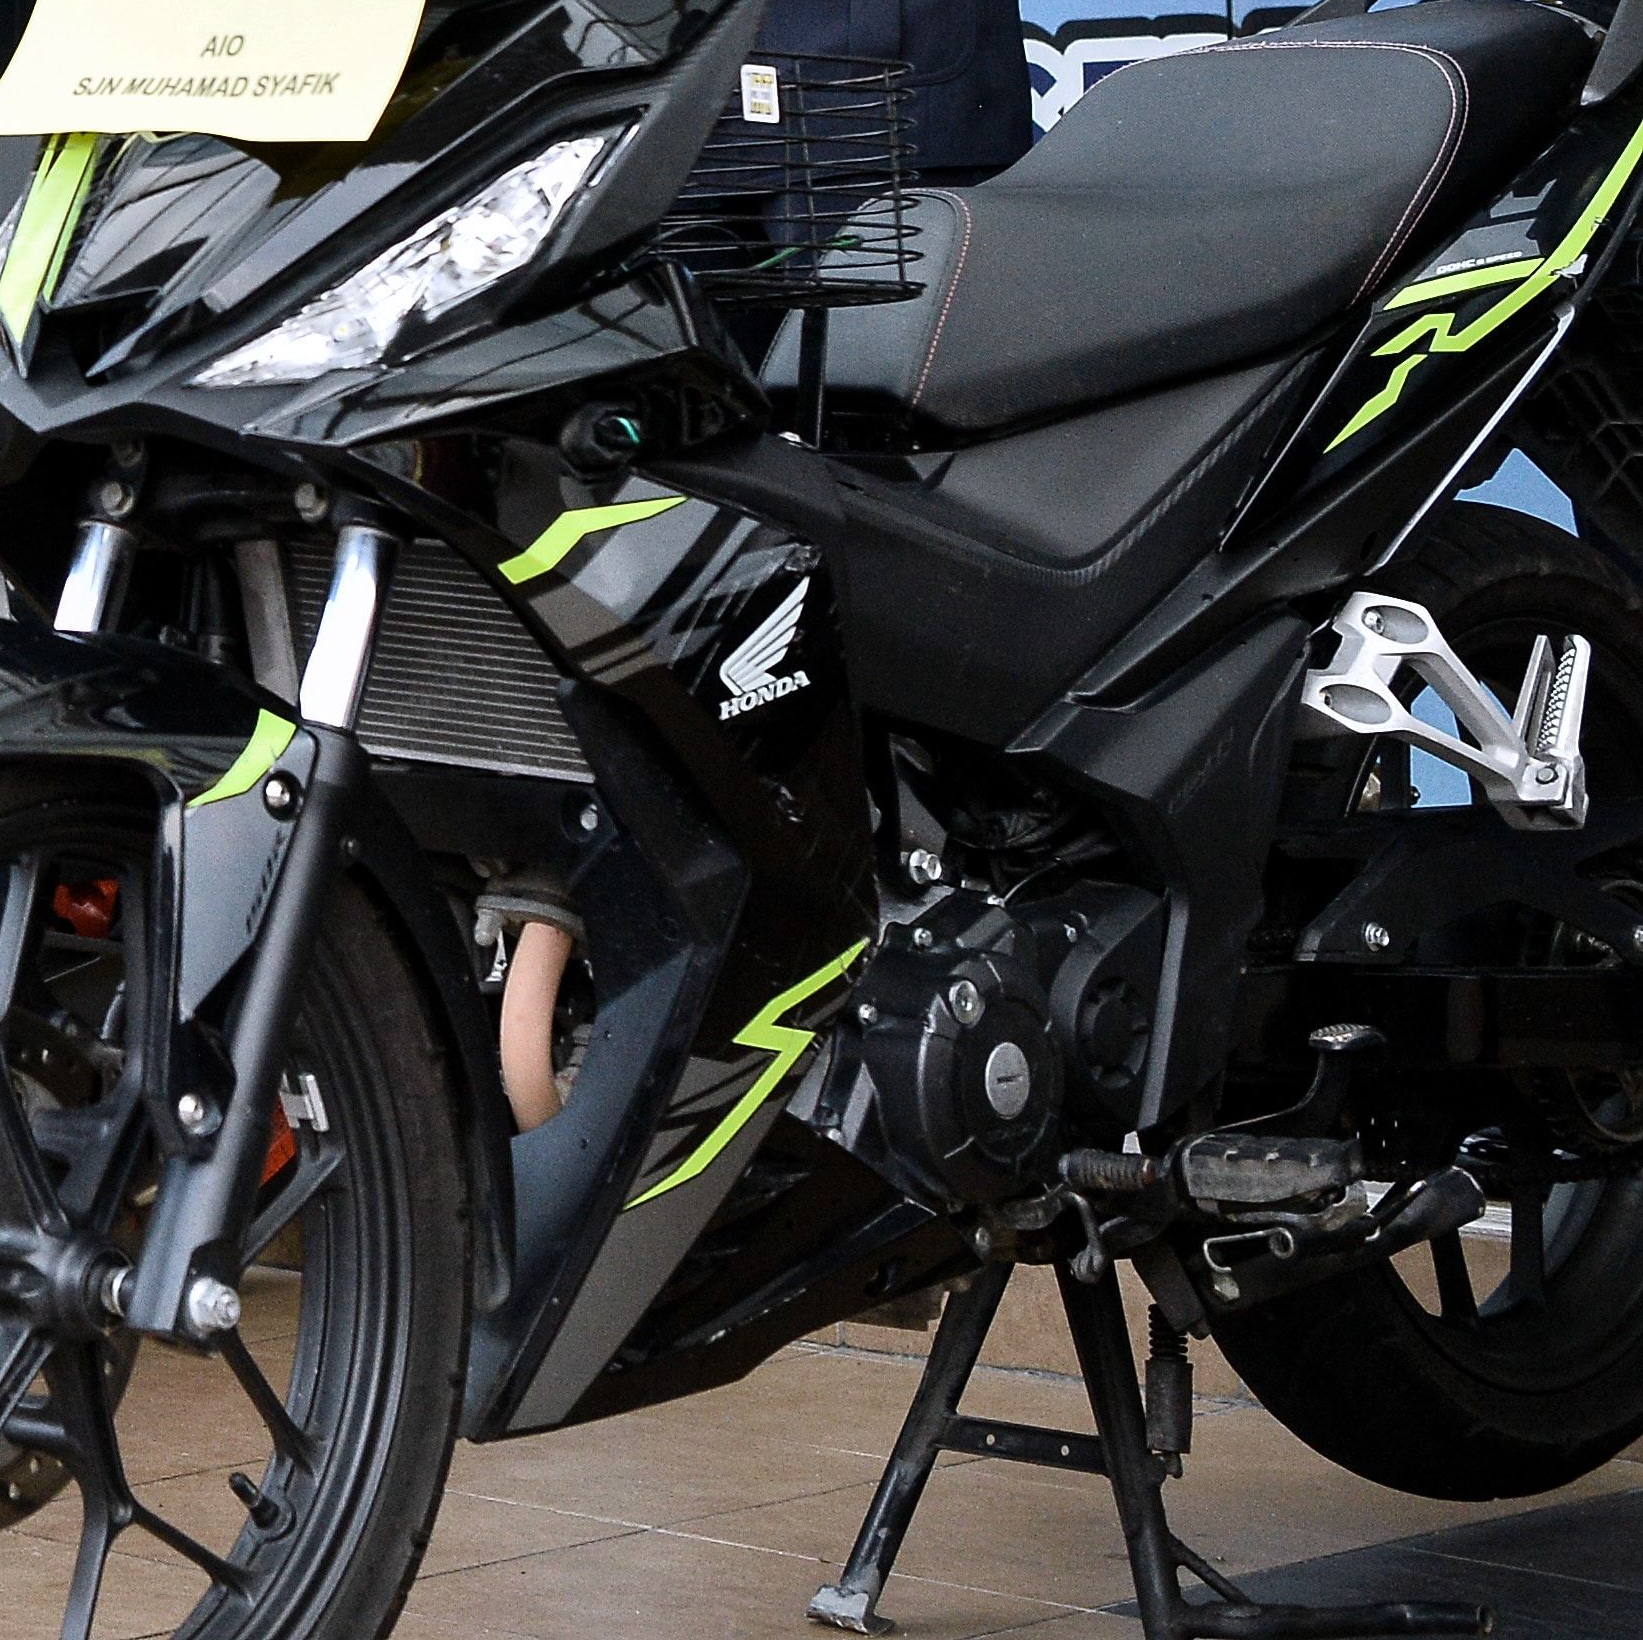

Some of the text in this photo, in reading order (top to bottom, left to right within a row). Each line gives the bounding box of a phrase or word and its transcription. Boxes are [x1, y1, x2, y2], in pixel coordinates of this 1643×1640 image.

[199, 34, 245, 58] AIO
[72, 71, 341, 98] SJN MUHAMAD SYAFIK
[718, 670, 811, 721] HONDA
